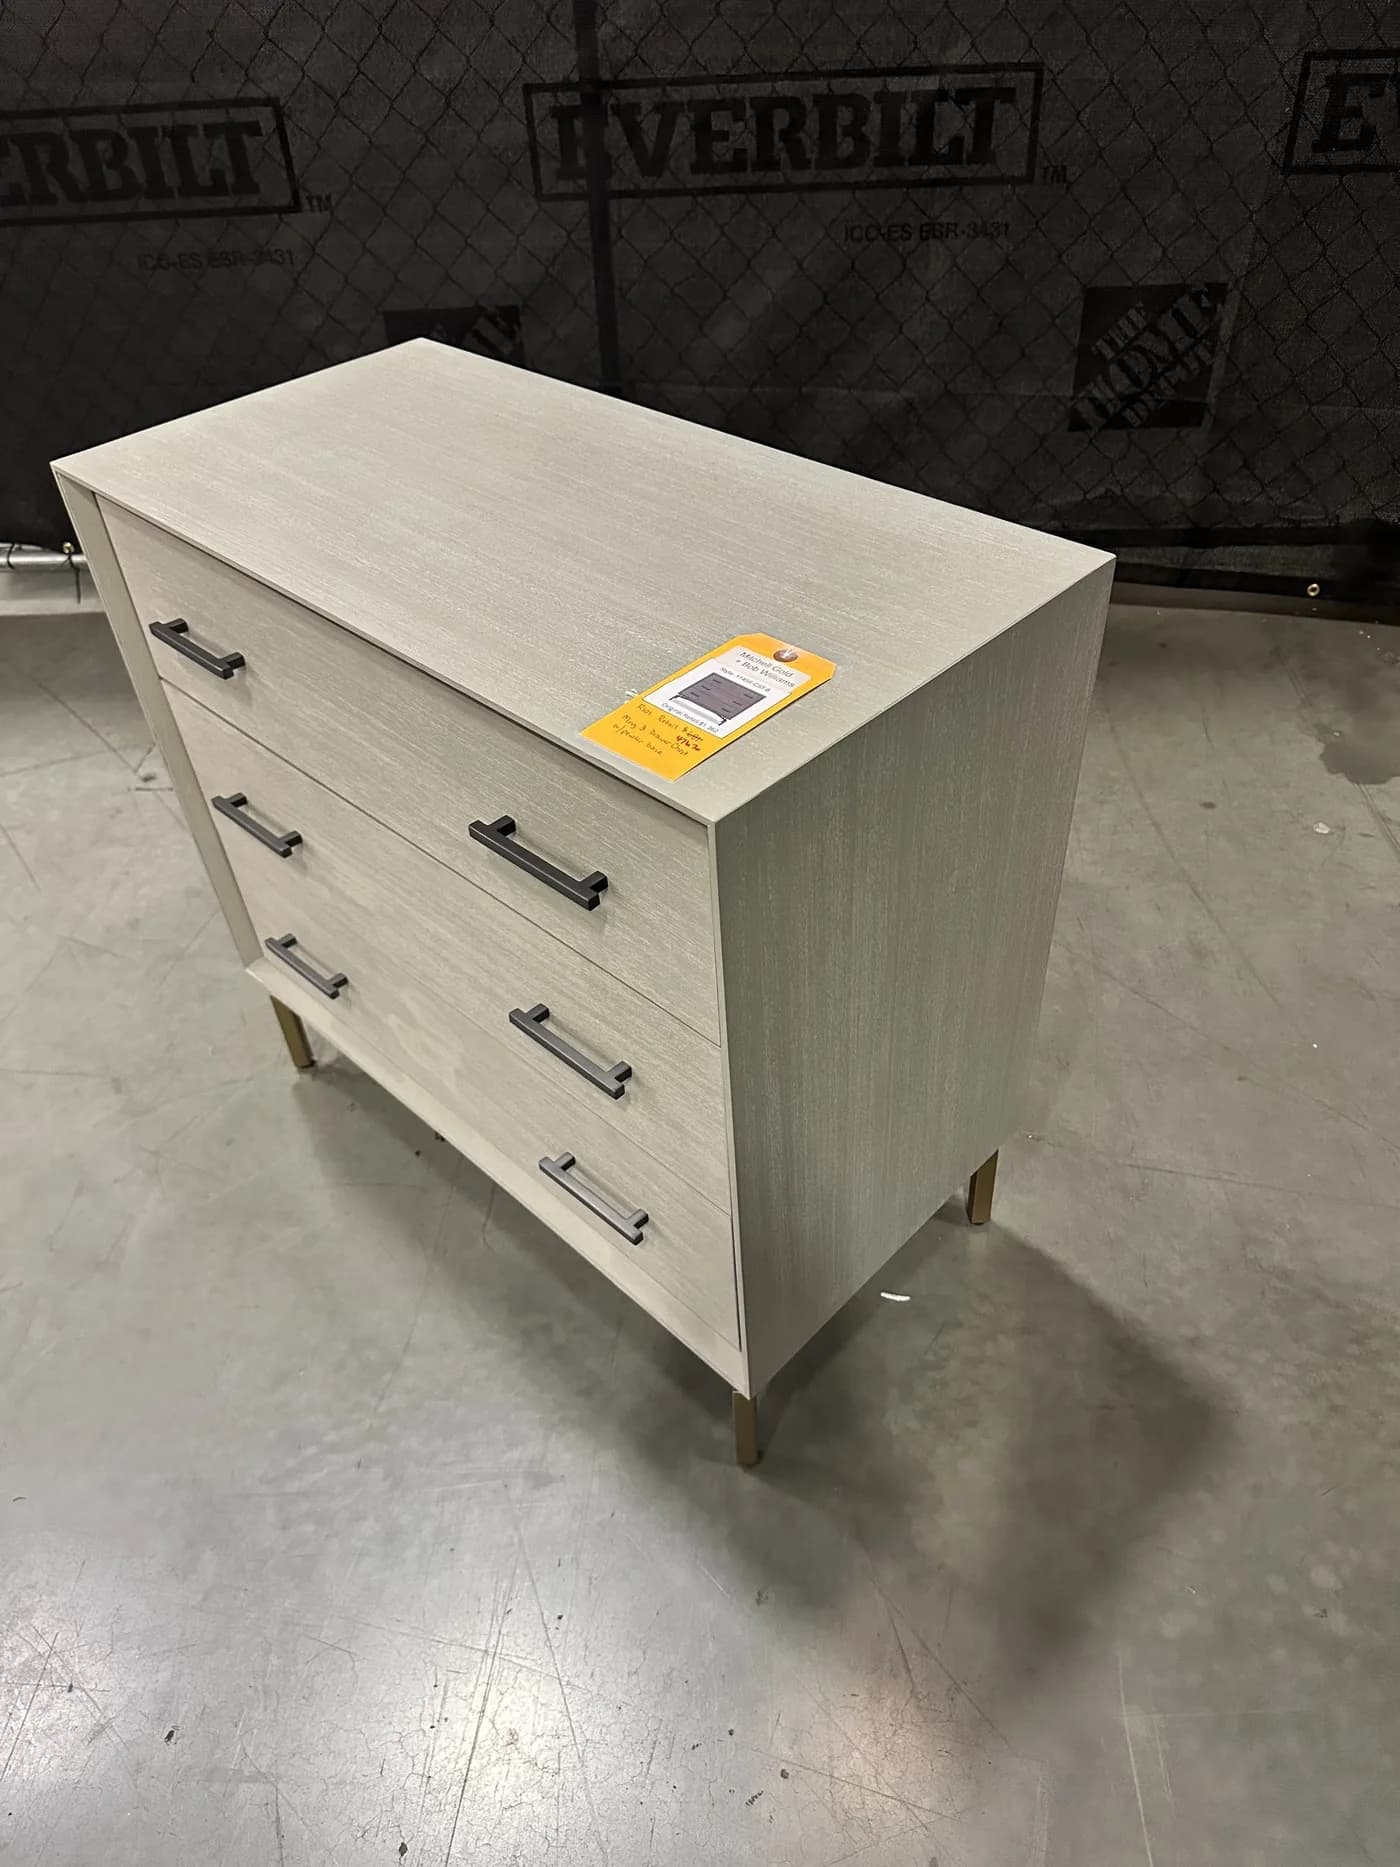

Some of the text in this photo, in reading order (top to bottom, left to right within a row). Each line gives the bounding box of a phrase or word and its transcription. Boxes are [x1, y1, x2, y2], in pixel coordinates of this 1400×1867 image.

[1312, 70, 1400, 153] E
[741, 661, 796, 688] Bob Wams
[771, 665, 794, 678] Gold
